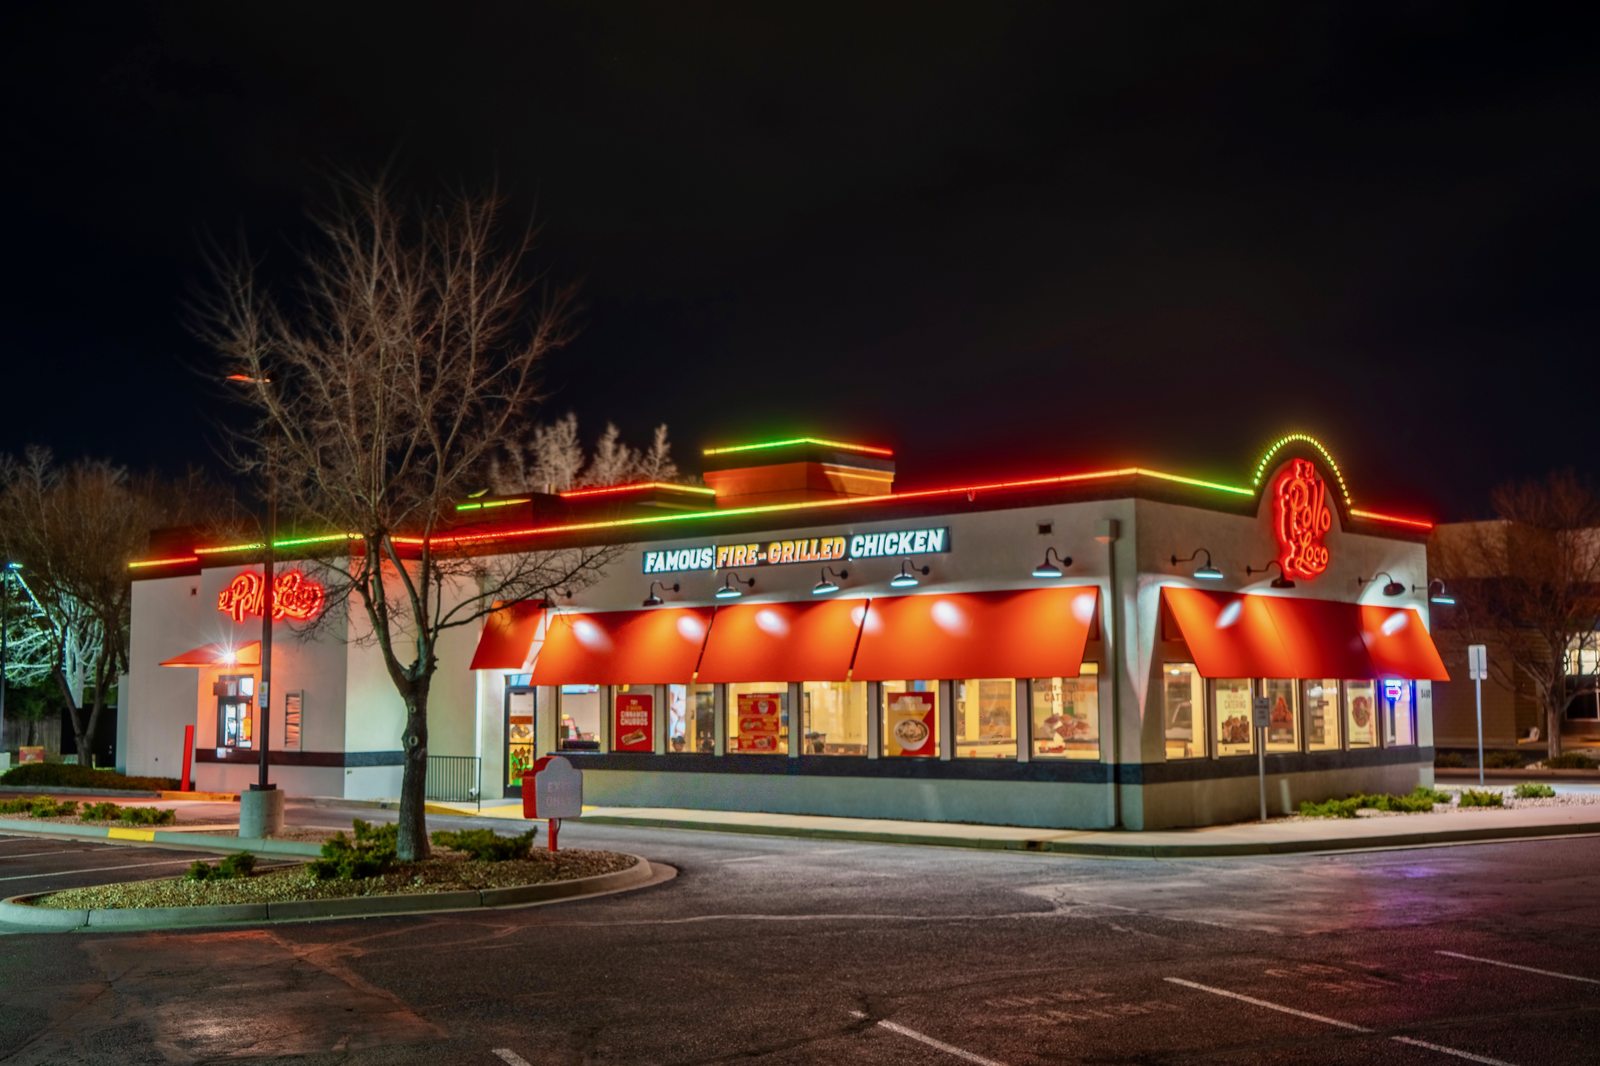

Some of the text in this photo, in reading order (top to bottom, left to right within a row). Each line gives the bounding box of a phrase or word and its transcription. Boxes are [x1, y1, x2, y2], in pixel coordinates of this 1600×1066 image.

[1289, 479, 1331, 541] Pollo
[645, 528, 944, 573] FAMOUS FIRE-GRILLED CHICKEN
[1295, 531, 1329, 572] Loco
[231, 575, 265, 621] Poll
